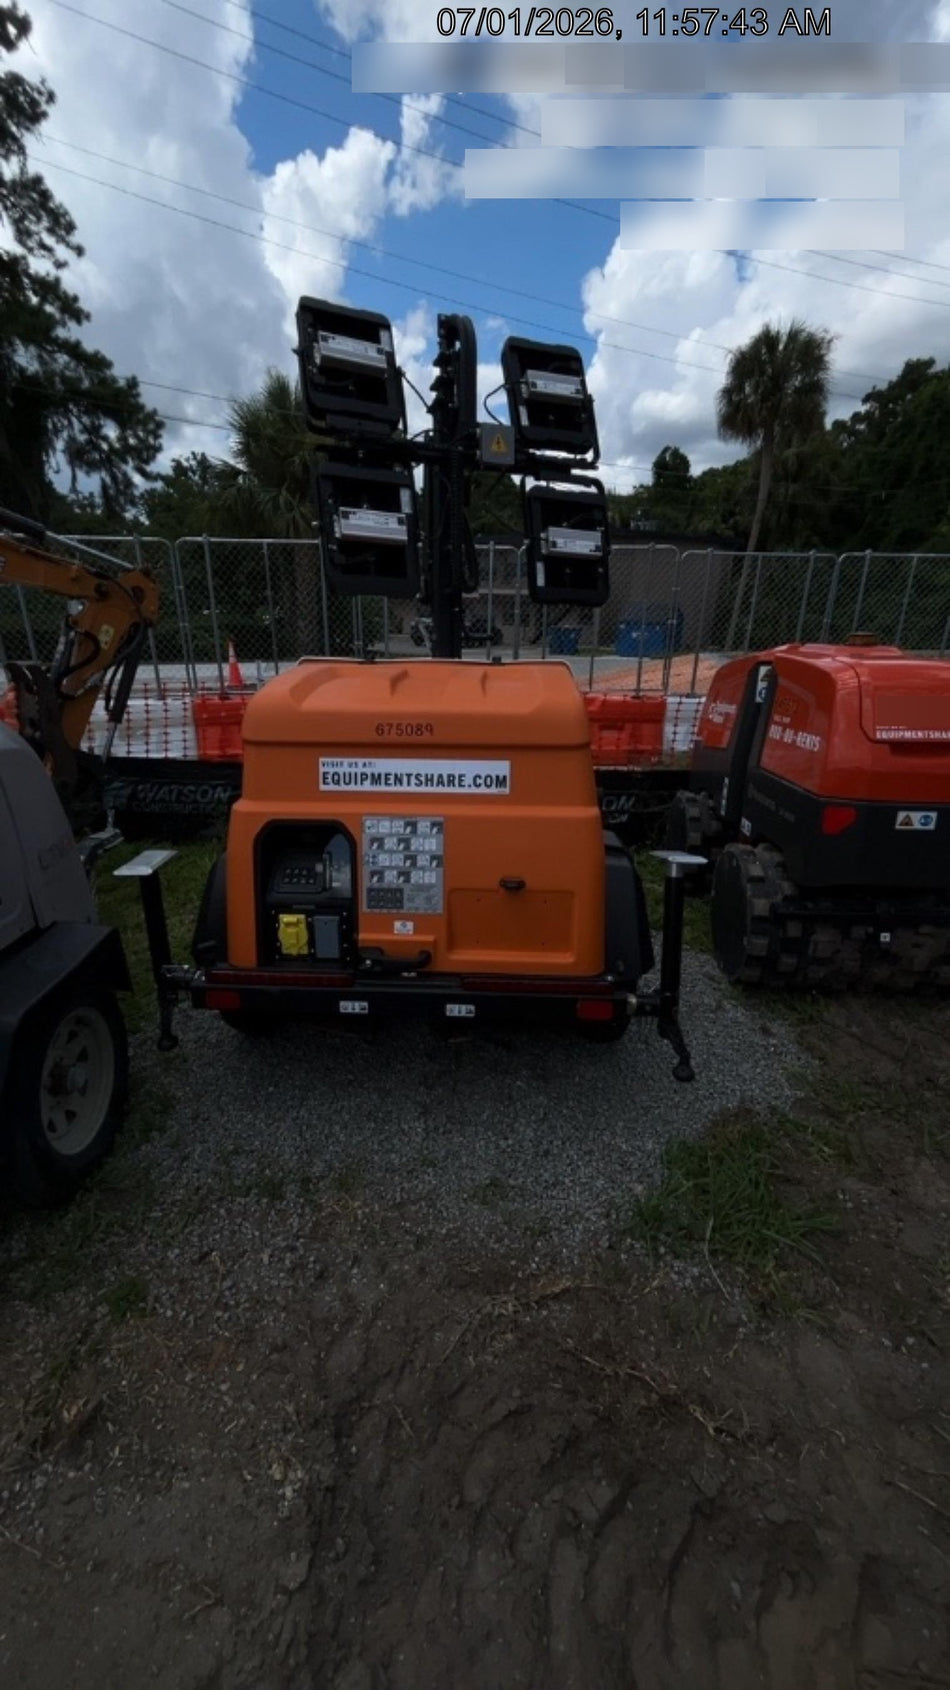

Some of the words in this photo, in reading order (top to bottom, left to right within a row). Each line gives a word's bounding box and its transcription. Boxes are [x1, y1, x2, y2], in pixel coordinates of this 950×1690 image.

[375, 723, 434, 737] 675089
[321, 760, 344, 768] VISIT
[321, 771, 508, 789] EQUIPMENTSHARE.COM
